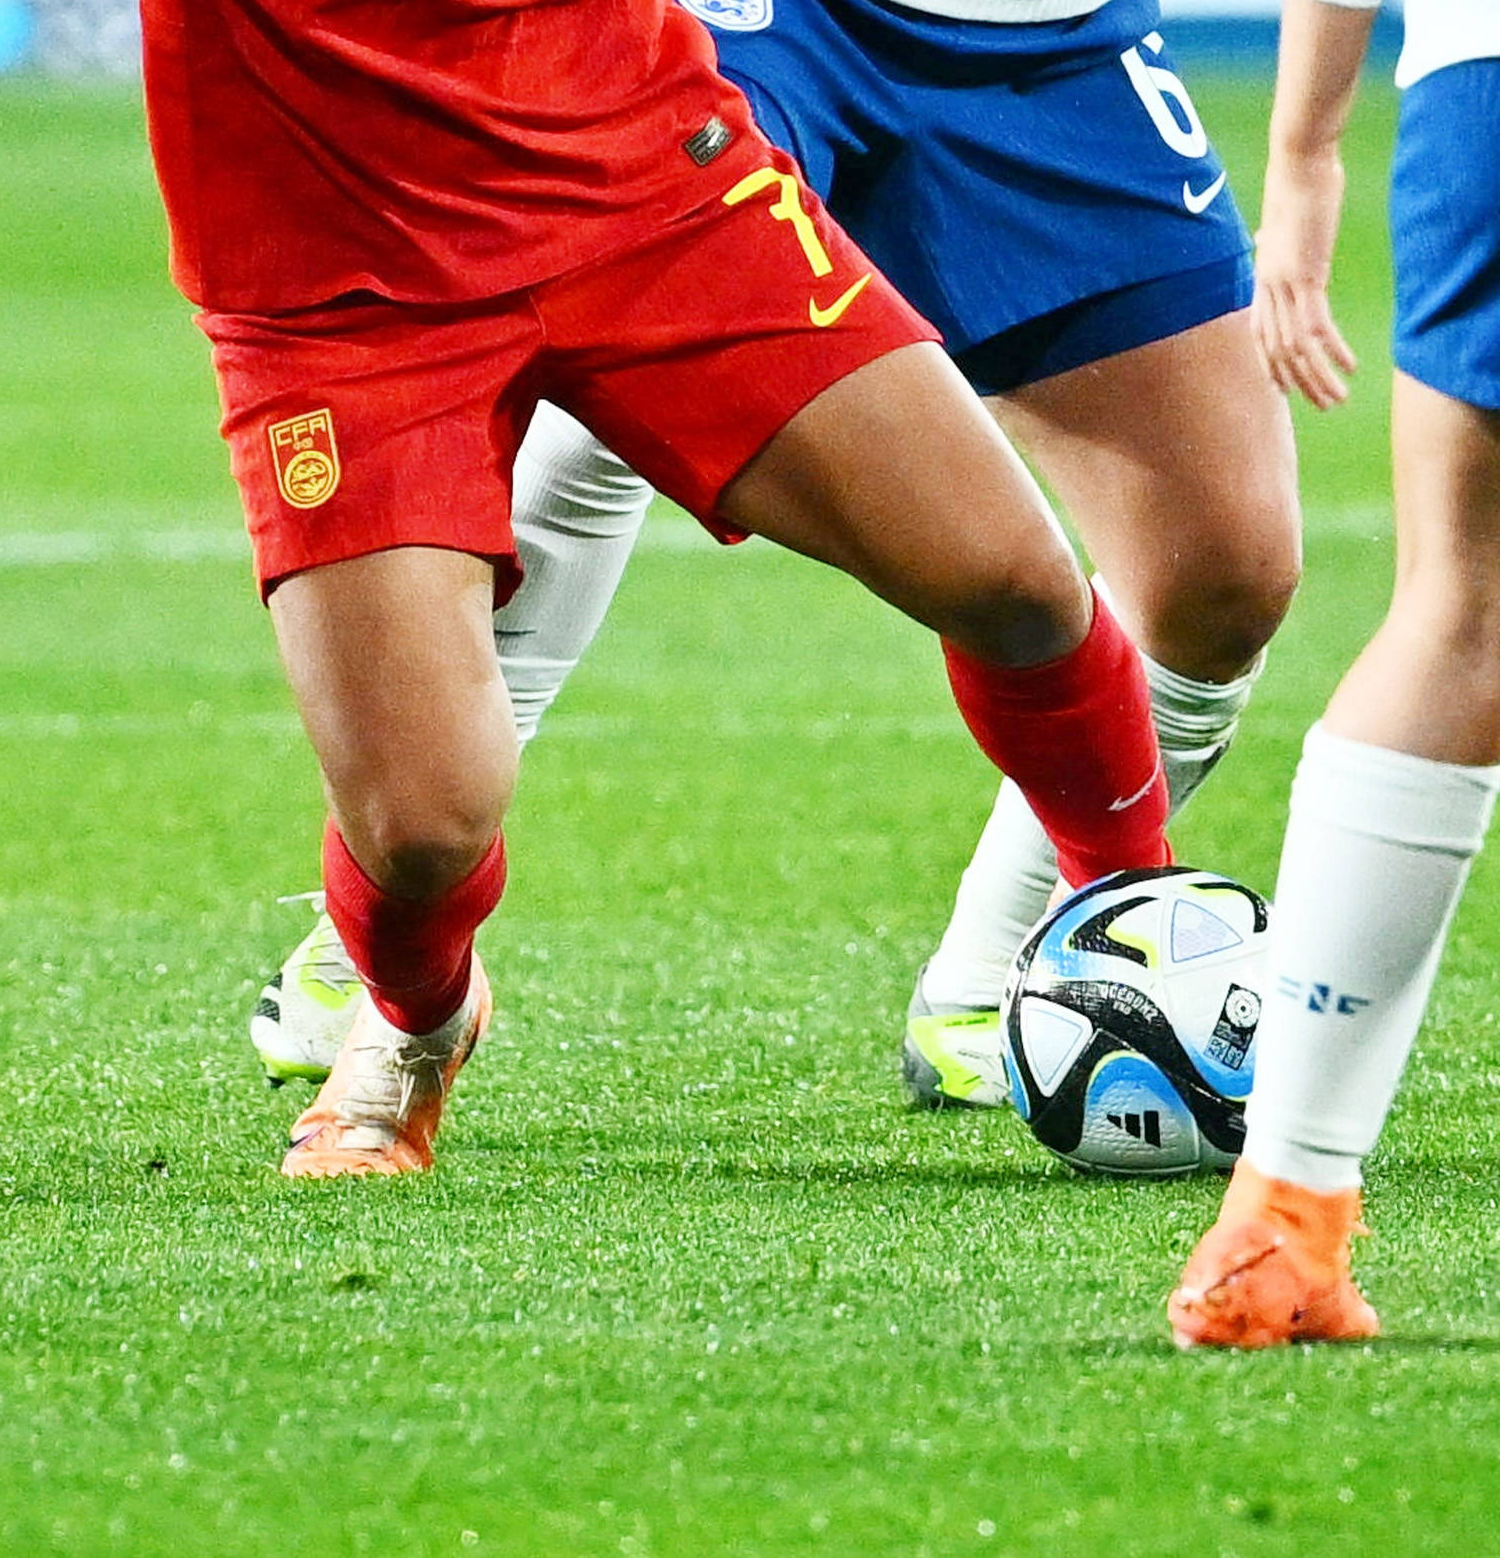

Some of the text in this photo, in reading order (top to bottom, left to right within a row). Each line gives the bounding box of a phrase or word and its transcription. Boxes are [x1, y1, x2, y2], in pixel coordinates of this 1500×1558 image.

[1120, 31, 1209, 159] 6
[722, 166, 833, 278] 7
[275, 415, 327, 448] CFA
